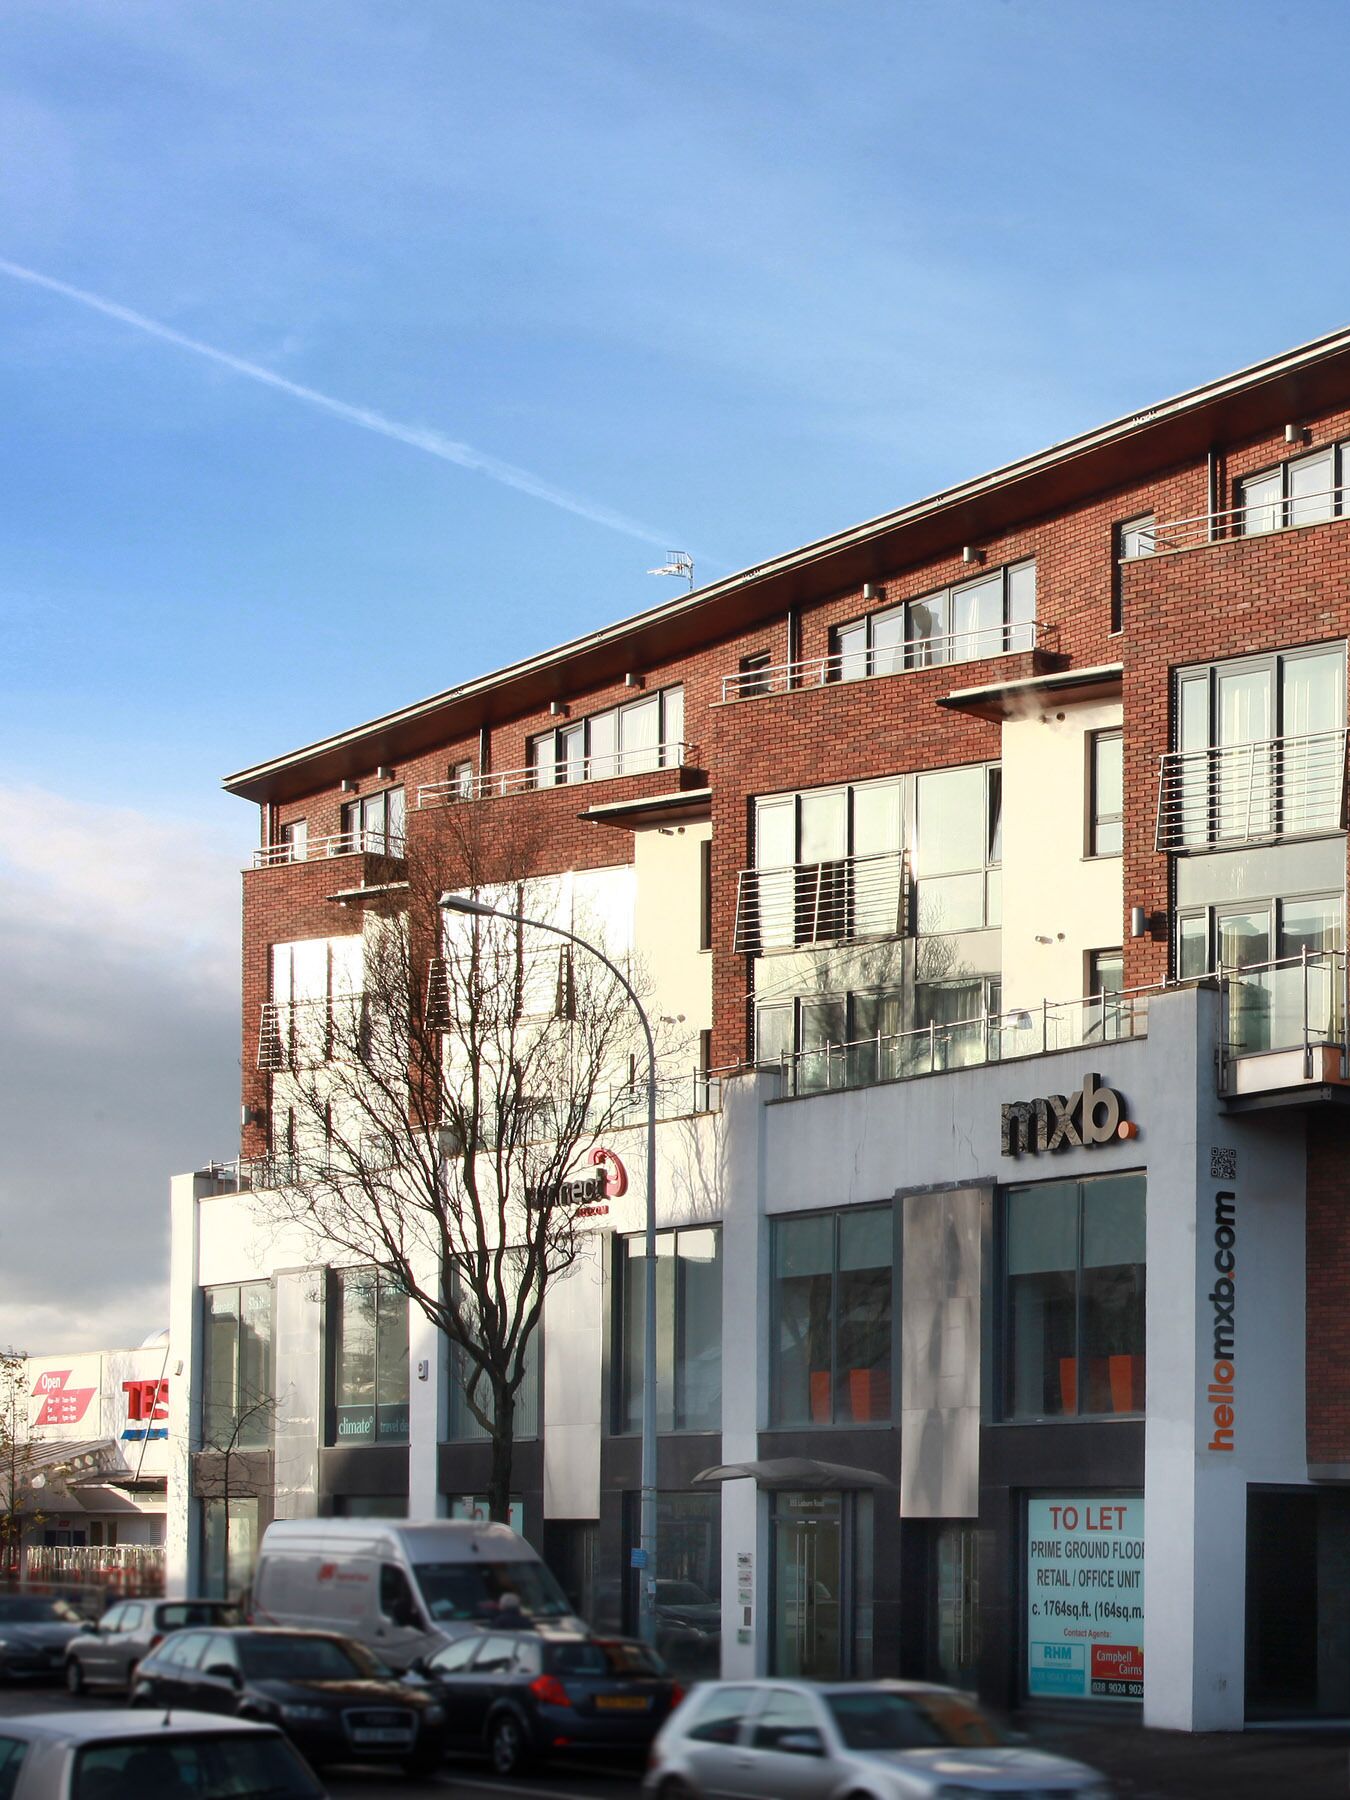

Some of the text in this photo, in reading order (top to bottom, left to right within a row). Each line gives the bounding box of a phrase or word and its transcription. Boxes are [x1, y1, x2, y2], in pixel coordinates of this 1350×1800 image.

[1001, 1072, 1136, 1157] mxb.
[1207, 1190, 1236, 1451] hellomxb.com
[41, 1373, 62, 1392] Open
[1049, 1506, 1127, 1531] TO LET
[1031, 1541, 1062, 1558] PRIME
[1065, 1541, 1110, 1559] GROUND
[1037, 1569, 1071, 1586] RETAIL
[1078, 1570, 1114, 1587] OFFICE
[1117, 1570, 1140, 1588] UNIT
[1032, 1604, 1041, 1615] c.
[1044, 1600, 1091, 1620] 1764sq.ft.
[1064, 1628, 1087, 1637] Contact
[1044, 1646, 1072, 1660] RHM
[1096, 1650, 1132, 1663] Campbell
[1119, 1663, 1142, 1675] Cairns
[1108, 1682, 1126, 1694] 9024
